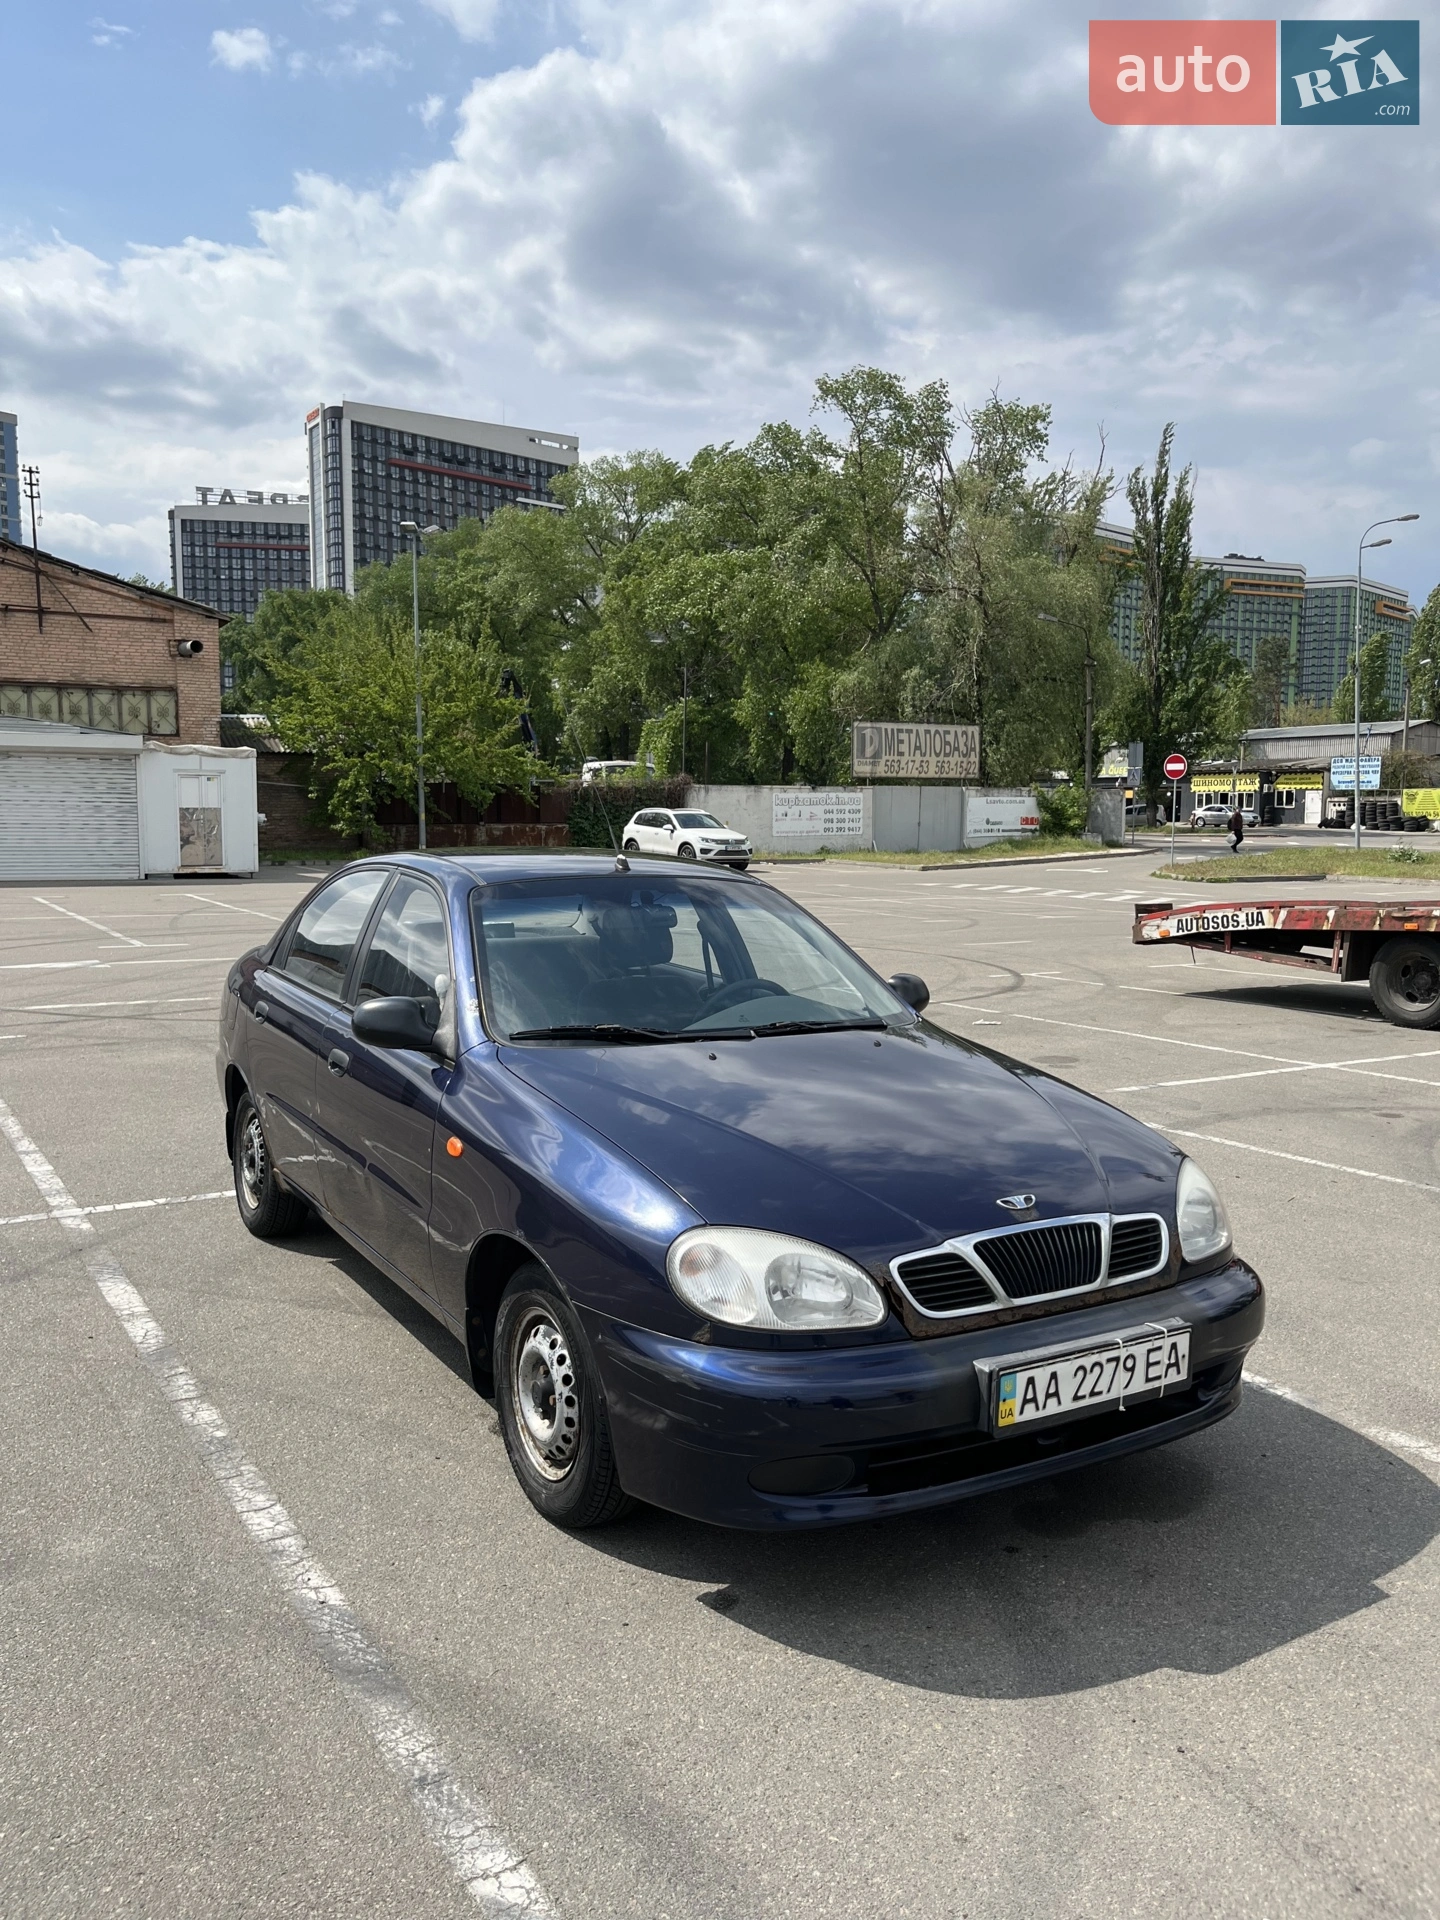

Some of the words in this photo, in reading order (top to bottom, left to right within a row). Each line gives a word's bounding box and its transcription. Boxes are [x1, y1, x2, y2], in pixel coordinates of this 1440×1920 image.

[884, 727, 978, 759] МЕТАЛОБАЗА
[857, 760, 881, 768] DIAMET
[883, 759, 930, 775] 563-17-53
[934, 760, 977, 776] 563-15-22
[1108, 764, 1128, 775] QUEE
[1193, 778, 1257, 787] ШИНОМОТАЖ
[775, 794, 861, 809] kupizamok.in.ua
[1176, 911, 1265, 933] AUTOSOS.UA
[1018, 1370, 1062, 1416] AA
[1070, 1353, 1137, 1404] 2279
[1144, 1341, 1182, 1384] EA
[1000, 1408, 1014, 1420] UA
